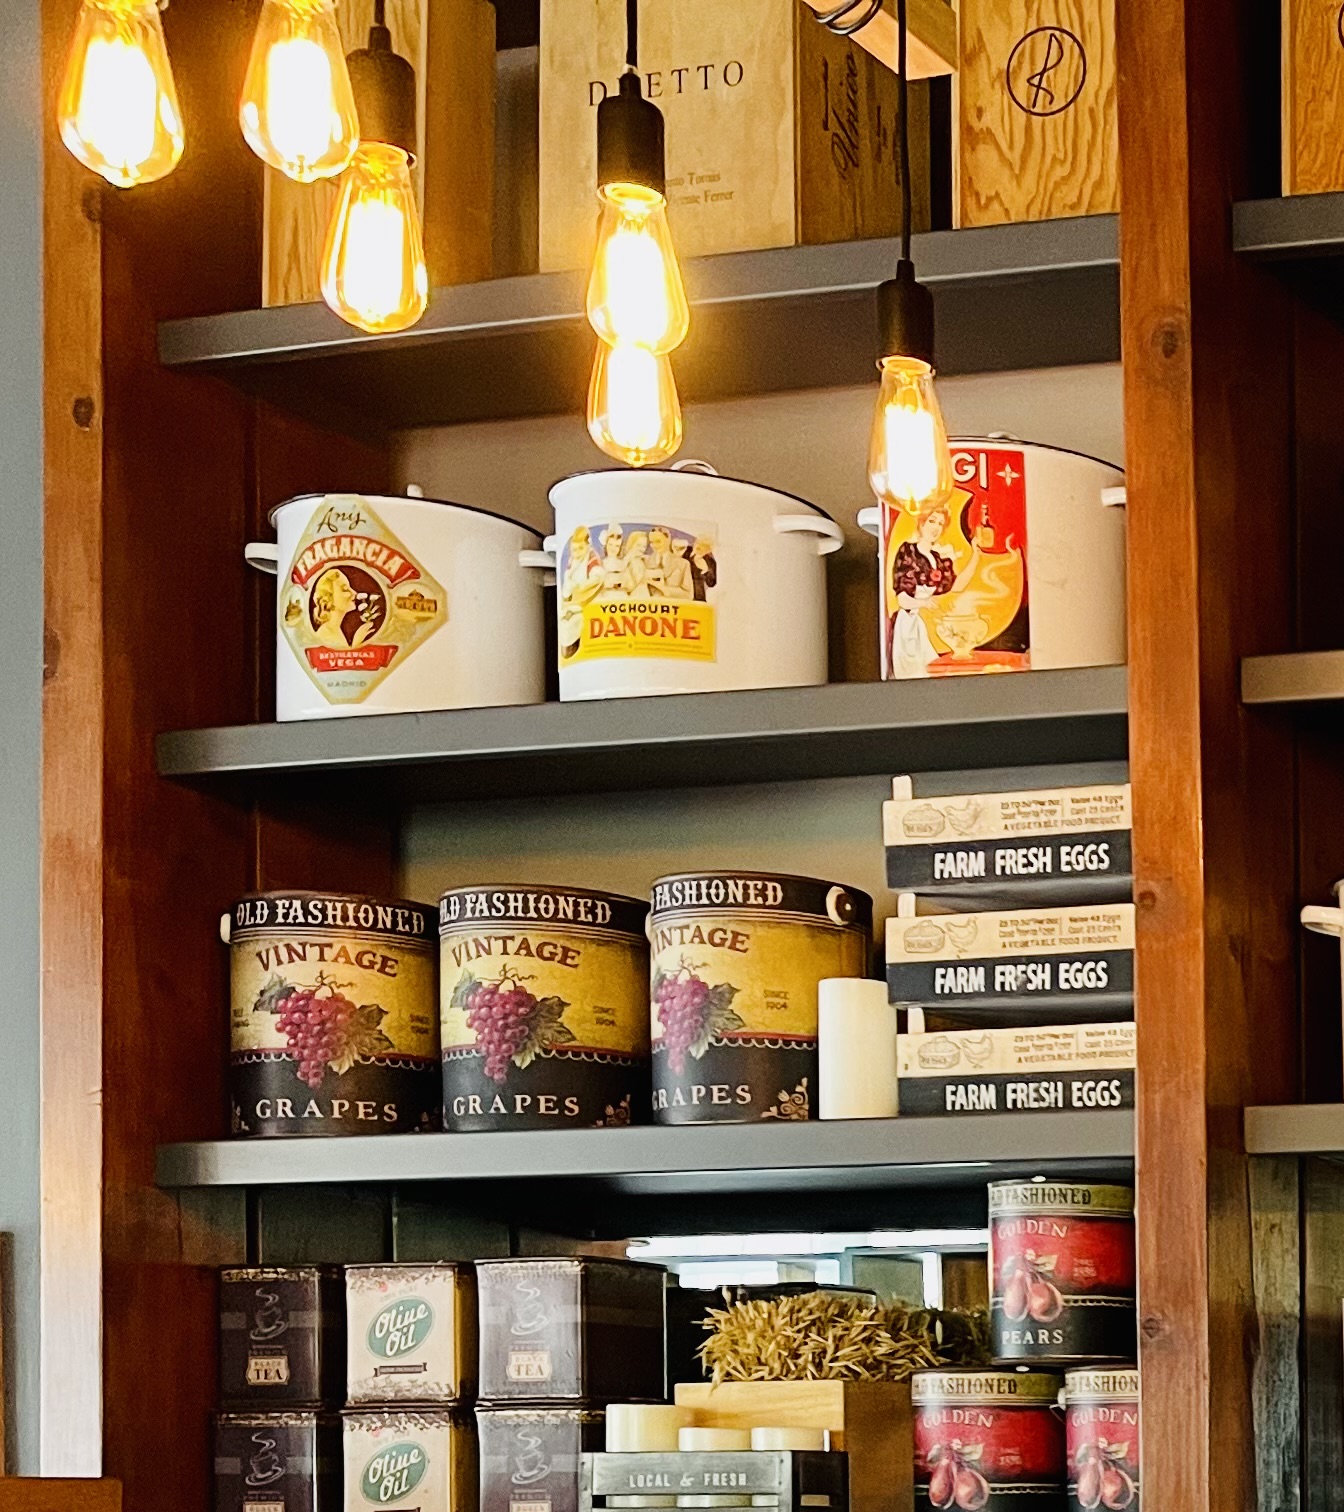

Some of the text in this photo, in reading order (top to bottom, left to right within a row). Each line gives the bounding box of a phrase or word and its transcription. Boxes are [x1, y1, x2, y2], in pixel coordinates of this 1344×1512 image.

[588, 60, 745, 107] DETTO
[296, 536, 404, 579] FRAGANCIA
[589, 616, 702, 642] DANONE
[328, 657, 364, 668] VEGA
[934, 842, 1111, 880] FARM FRESH EGGS
[464, 892, 612, 925] FASHIONED
[653, 879, 784, 909] FASHIONED
[236, 899, 425, 935] OLD FASHIONED
[451, 935, 582, 969] VINTAGE
[652, 925, 750, 959] INTAGE
[256, 941, 400, 978] VINTAGE
[934, 960, 1109, 996] FARM FRESH EGGS
[255, 1097, 399, 1123] GRAPES
[453, 1094, 581, 1117] GRAPES
[945, 1079, 1121, 1112] FARM FRESH EGGS
[997, 1219, 1069, 1240] GOLDEN
[375, 1301, 430, 1340] Olive
[386, 1325, 417, 1358] Oil
[1002, 1328, 1064, 1346] PEARS
[253, 1367, 284, 1382] TEA
[515, 1364, 545, 1377] TEA
[923, 1408, 995, 1429] GOLDEN
[1072, 1407, 1138, 1428] GOLDEN
[368, 1448, 424, 1485] Olive
[629, 1474, 671, 1488] LOCAL
[703, 1471, 747, 1487] FRESH
[380, 1472, 410, 1504] Oil
